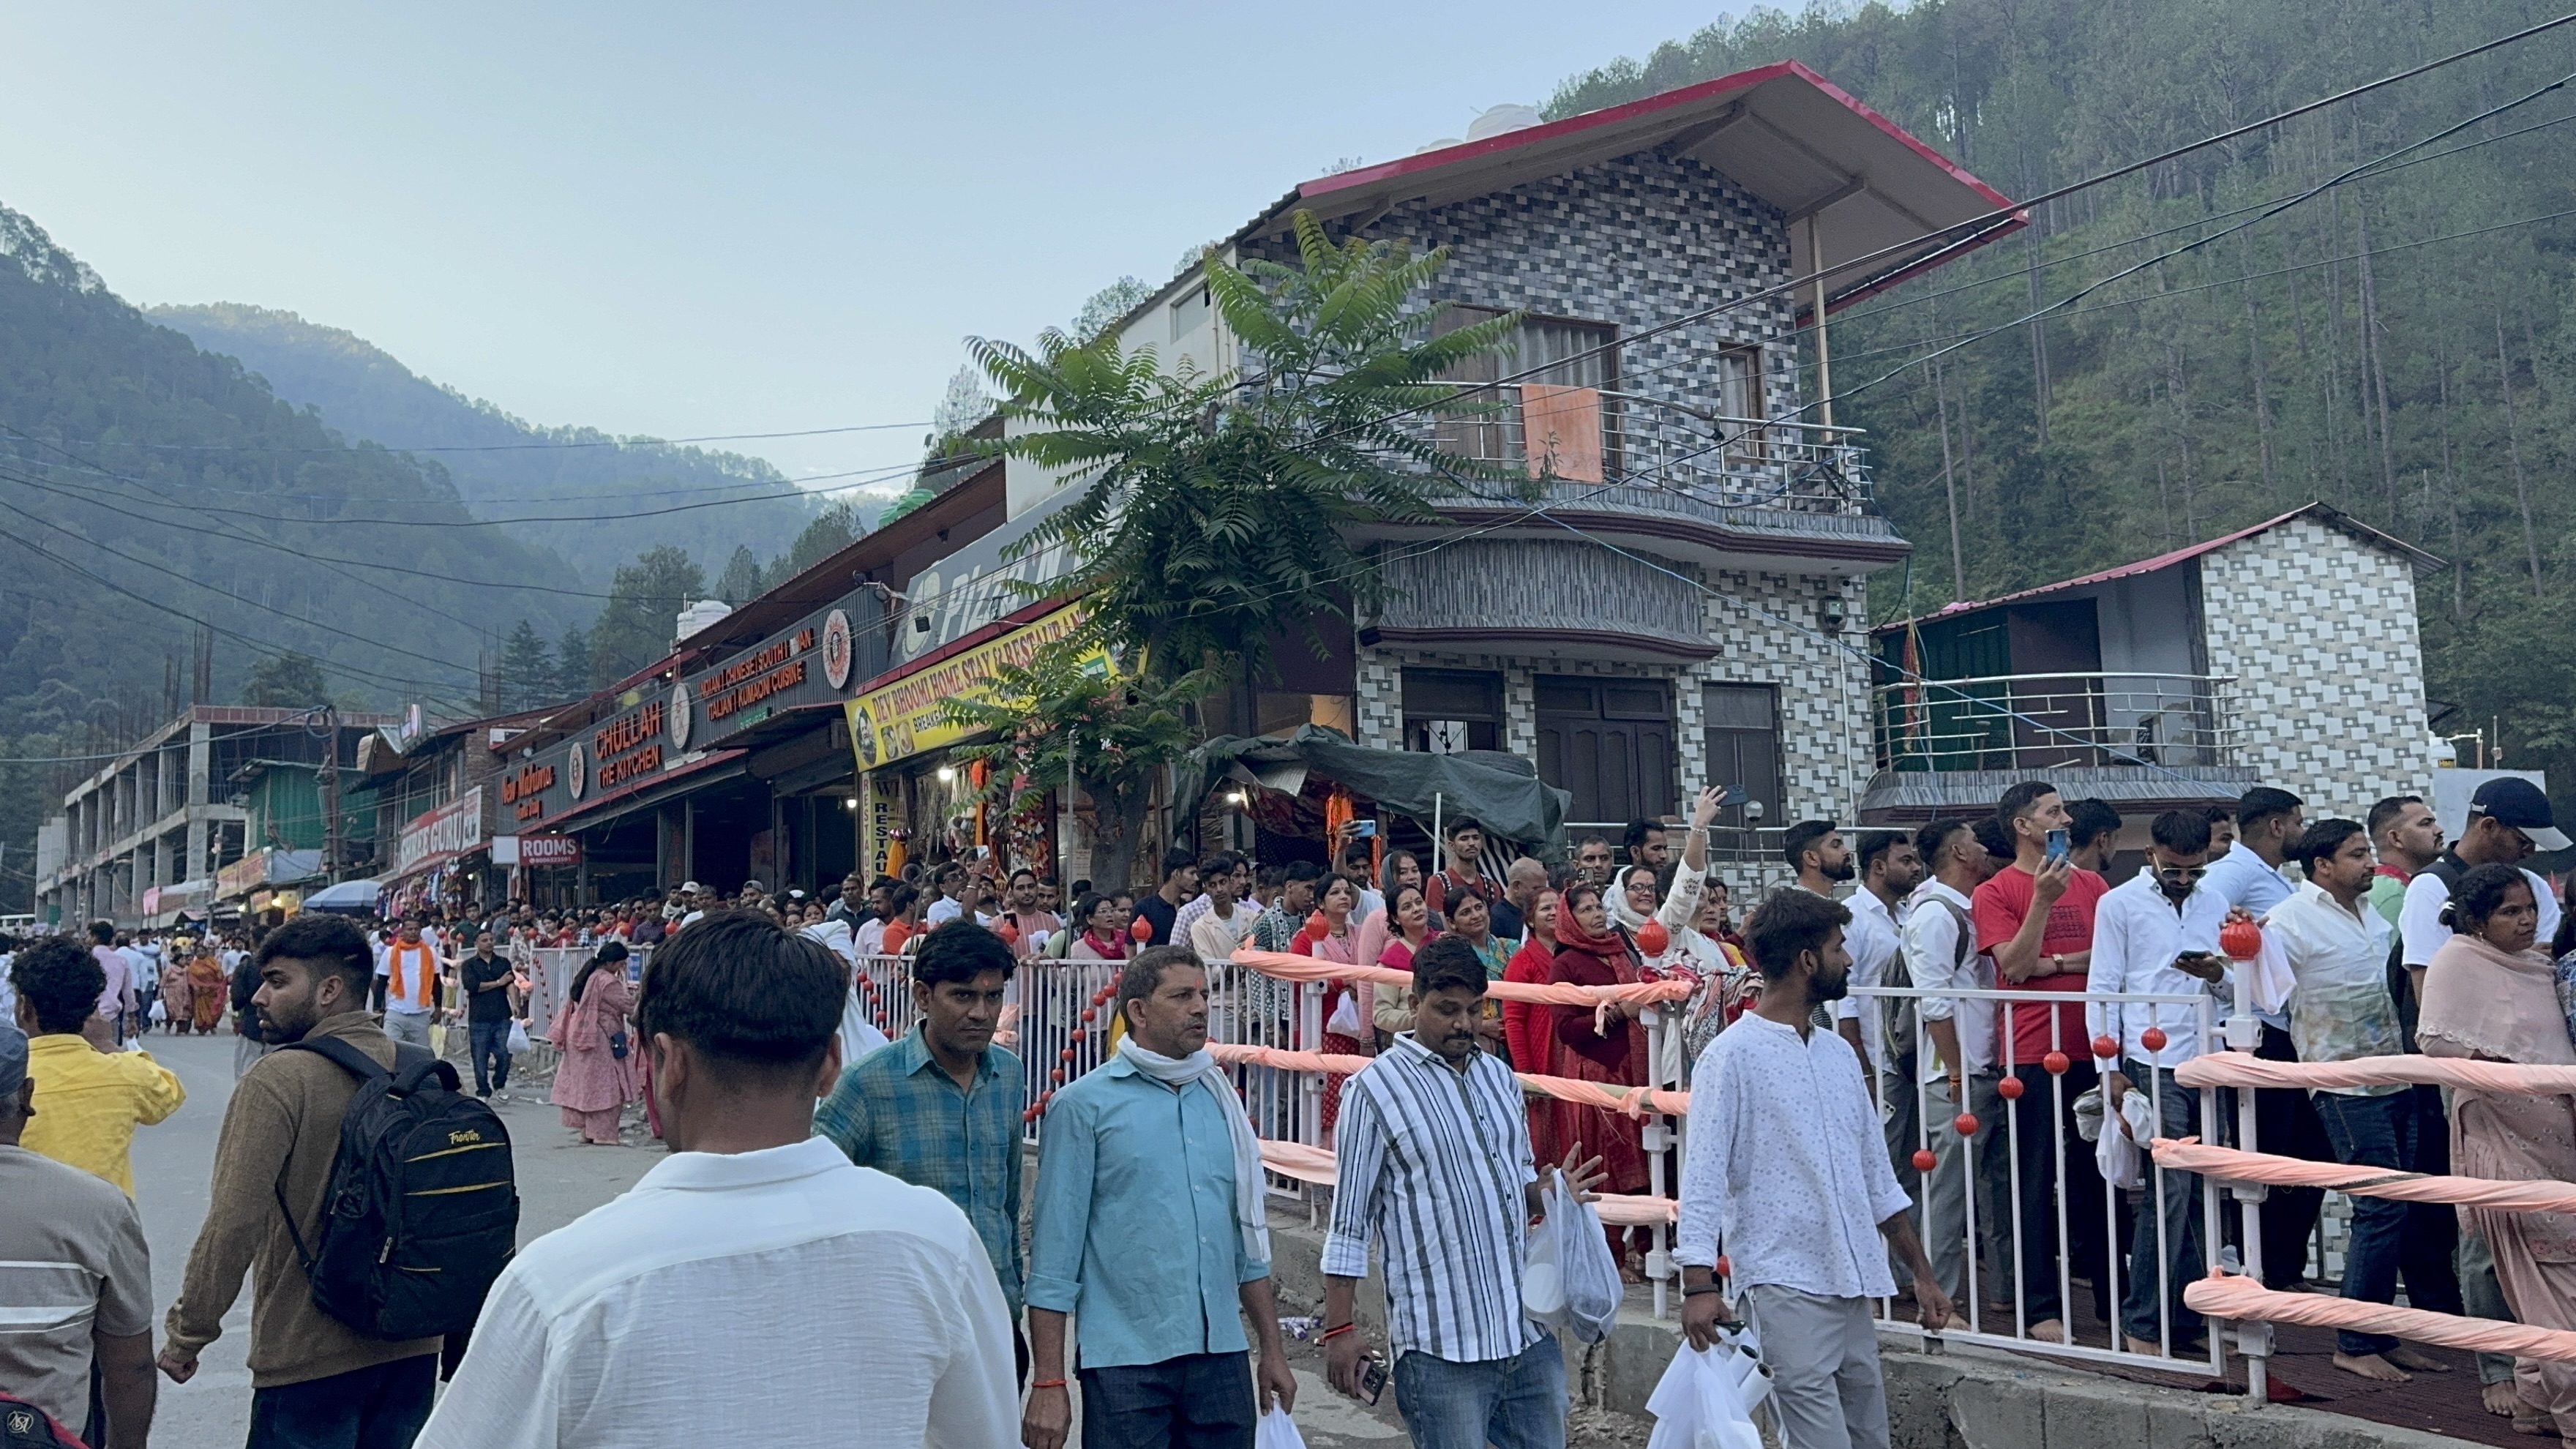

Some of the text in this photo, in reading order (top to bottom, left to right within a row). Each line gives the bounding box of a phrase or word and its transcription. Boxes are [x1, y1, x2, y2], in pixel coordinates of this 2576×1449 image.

[725, 656, 755, 686] CHINESE
[758, 642, 784, 670] SOUTH
[771, 662, 804, 692] CUISINE
[872, 692, 892, 724] DEV
[891, 676, 930, 716] BHOOMI
[931, 664, 964, 701] HOME
[962, 651, 992, 689] STAY
[992, 645, 1003, 667] &
[595, 701, 662, 760] CHULLAH
[596, 744, 659, 789] THE KITCHEN
[430, 810, 463, 853] GURU
[523, 839, 577, 857] ROOMS
[875, 803, 888, 879] RESTAU
[448, 1129, 481, 1145] Frontier
